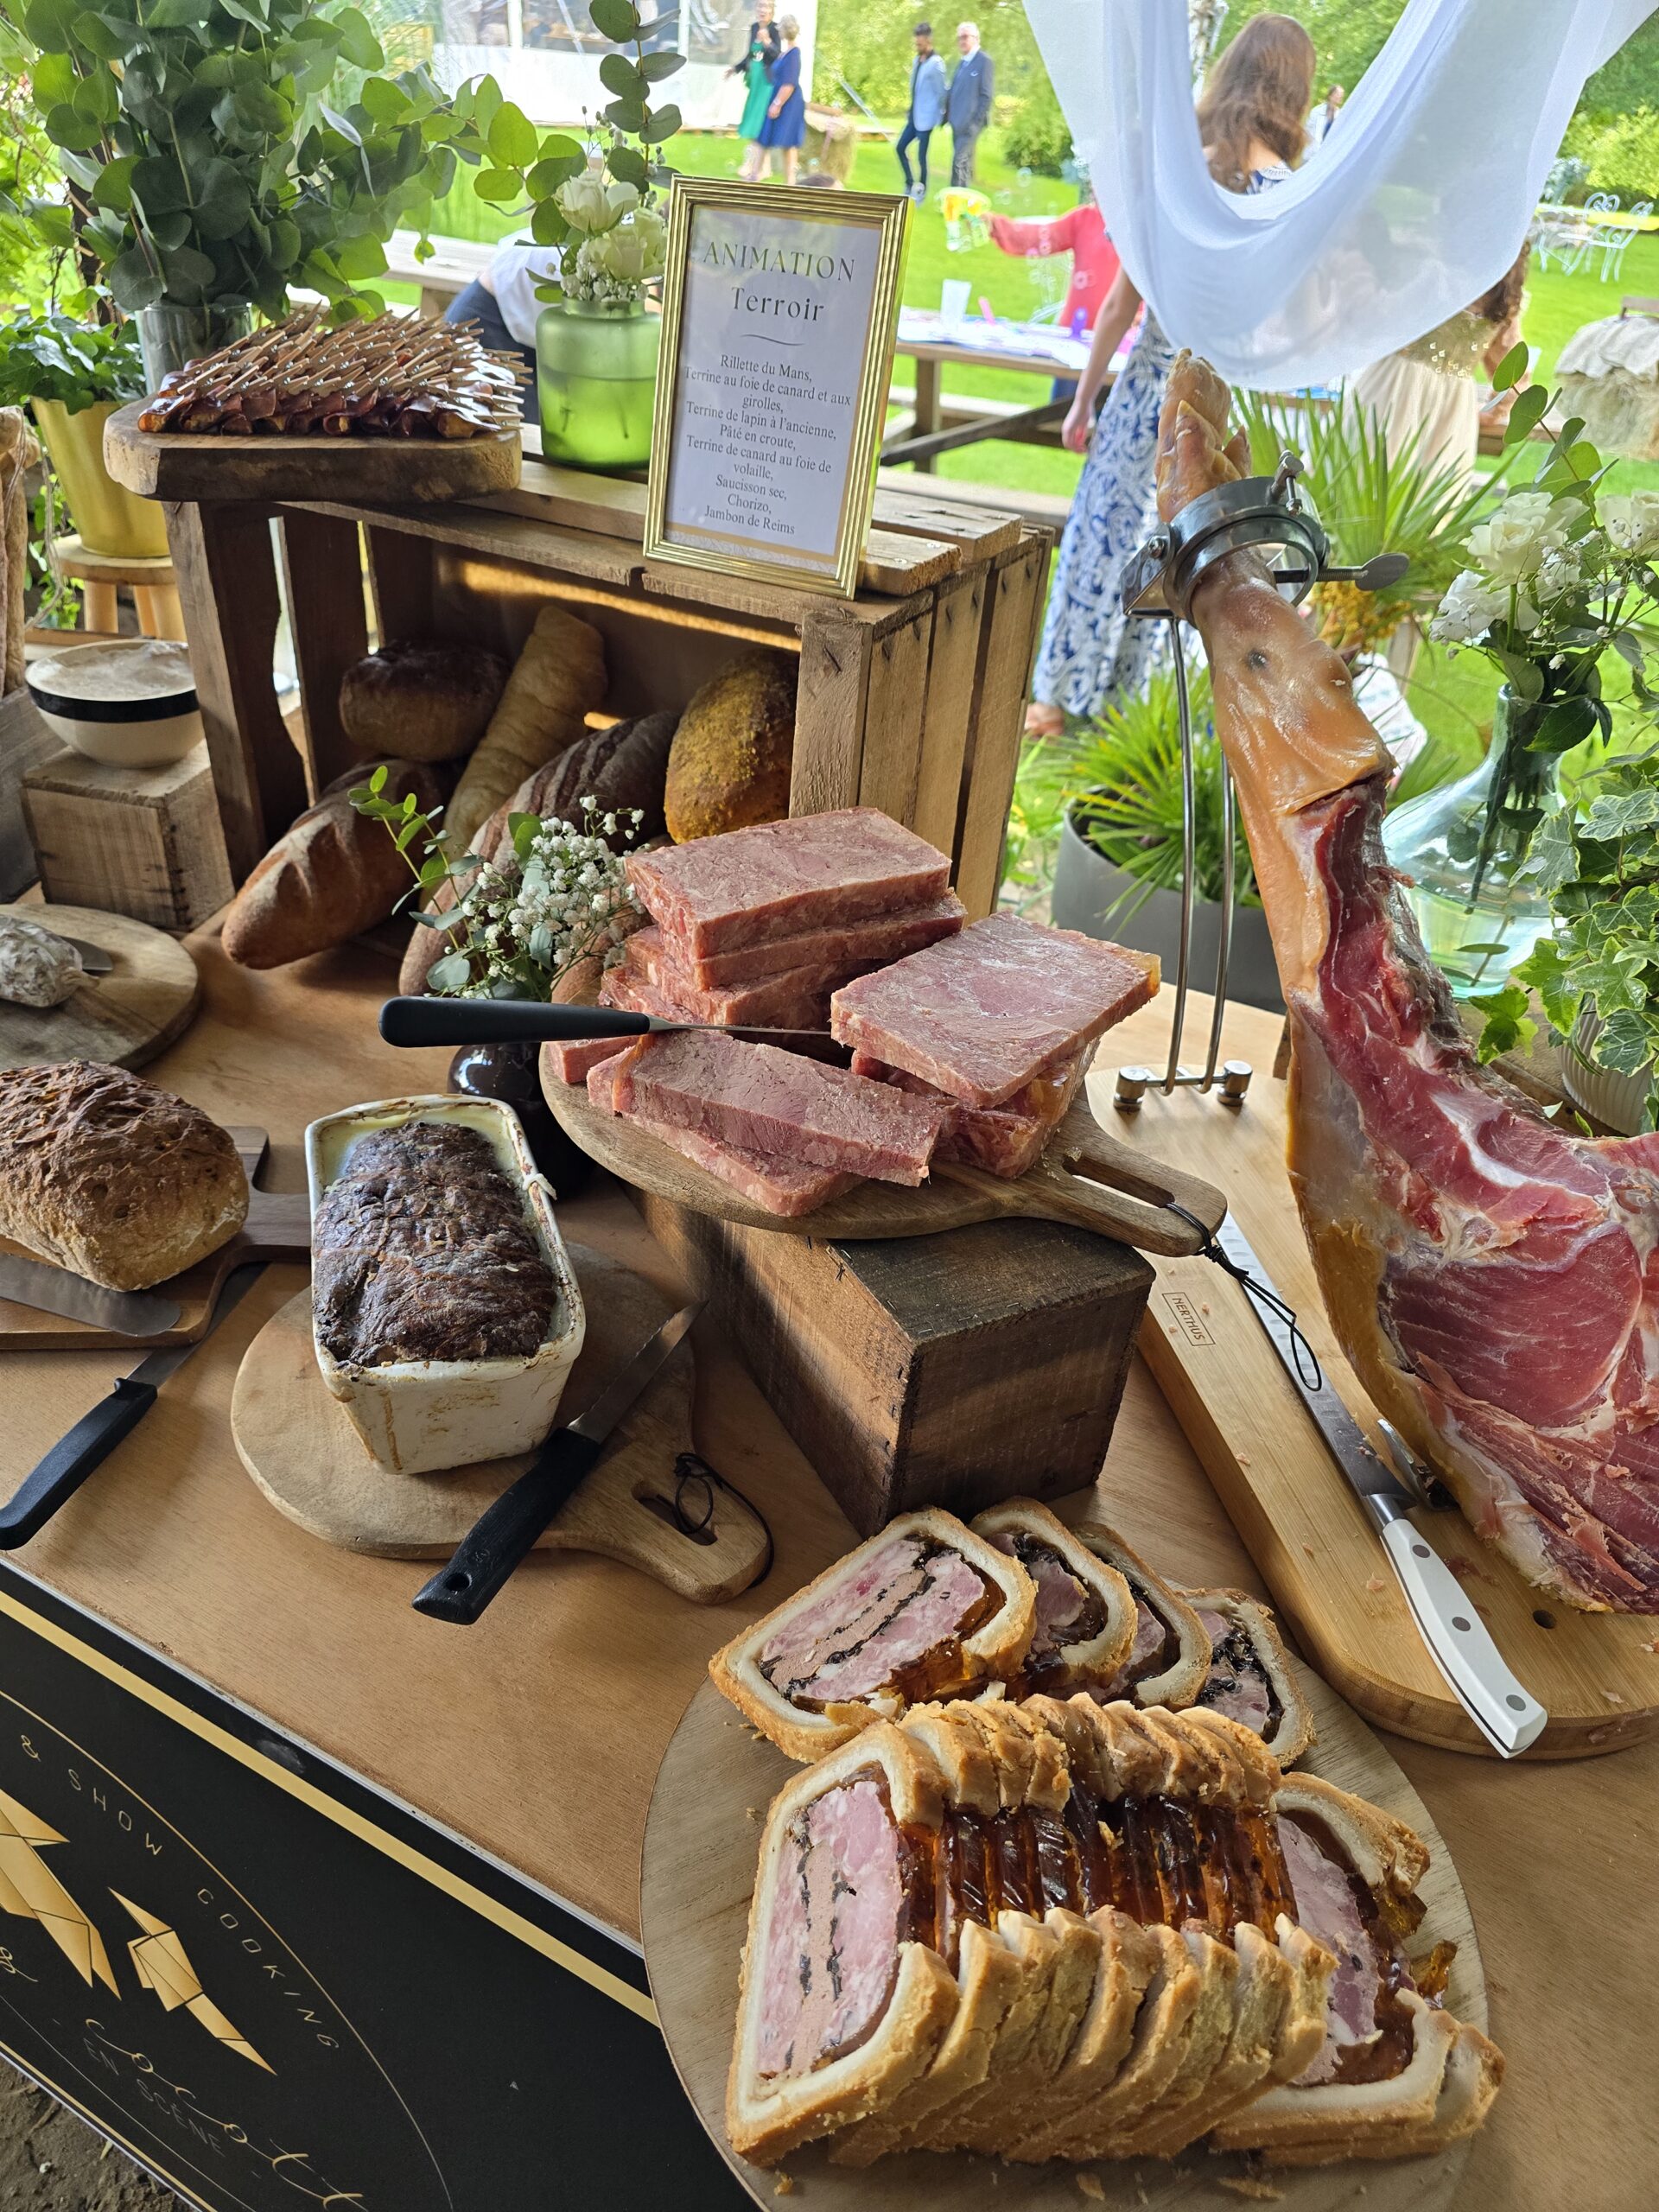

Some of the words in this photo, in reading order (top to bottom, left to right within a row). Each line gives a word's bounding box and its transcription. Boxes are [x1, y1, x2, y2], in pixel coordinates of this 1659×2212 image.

[702, 241, 856, 282] ANIMATION
[731, 286, 824, 321] Terroir
[720, 354, 760, 373] Rillette
[761, 361, 775, 375] du
[779, 364, 812, 383] Mans,
[683, 366, 721, 385] Terrine
[723, 376, 736, 387] au
[740, 376, 760, 391] foie
[762, 379, 775, 393] de
[777, 385, 815, 400] canard
[817, 391, 828, 402] et
[830, 394, 851, 406] aux
[686, 401, 723, 419] Terrine
[726, 408, 739, 422] de
[741, 410, 767, 429] lapin
[770, 416, 777, 429] à
[741, 395, 784, 413] girolles,
[720, 423, 742, 439] Pâté
[744, 432, 757, 442] en
[760, 435, 796, 451] croute,
[686, 435, 723, 454] Terrine
[726, 442, 739, 455] de
[741, 448, 777, 463] canard
[779, 454, 792, 467] au
[795, 454, 816, 472] foie
[818, 460, 831, 474] de
[715, 474, 766, 495] Saucisson
[769, 486, 787, 500] sec,
[734, 463, 773, 481] volaille,
[728, 493, 772, 514] Chorizo,
[704, 505, 745, 524] Jambon
[747, 512, 760, 527] de
[763, 517, 795, 535] Reims
[1172, 1298, 1205, 1340] NERTHUS
[21, 1735, 41, 1763] &
[67, 1769, 162, 1855] SHOW
[197, 1888, 339, 2049] COOKING
[83, 2037, 119, 2075] EN
